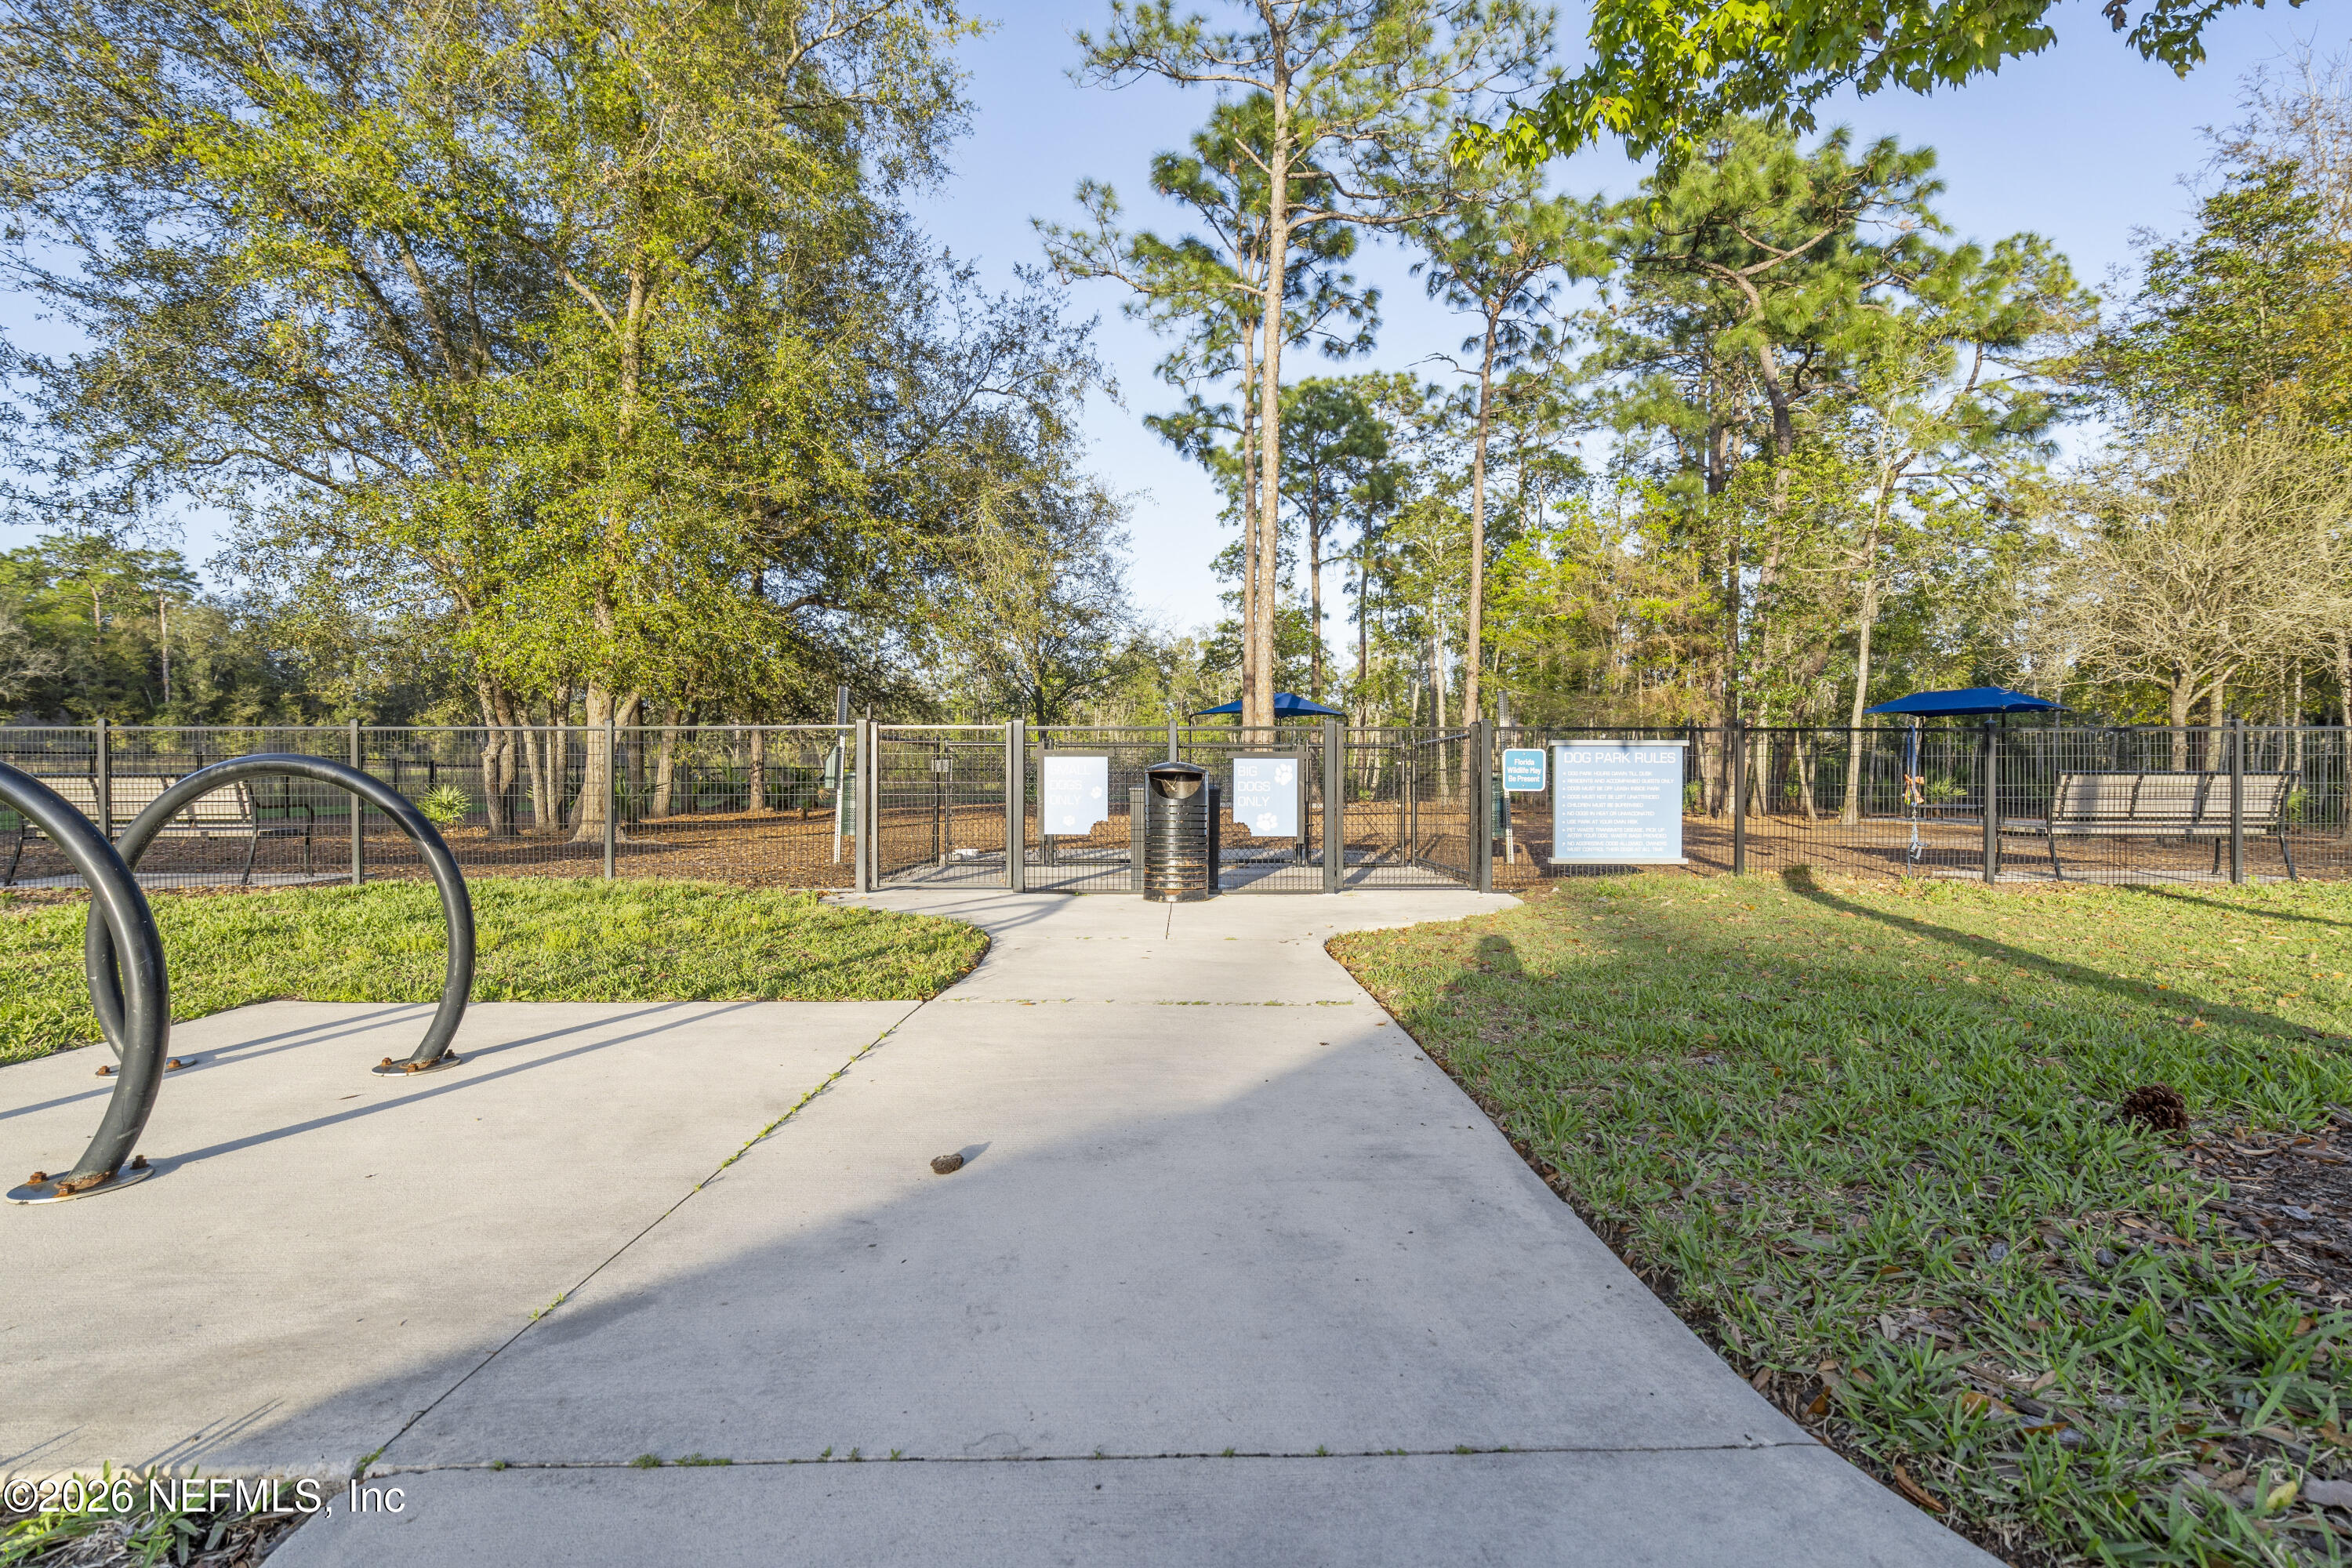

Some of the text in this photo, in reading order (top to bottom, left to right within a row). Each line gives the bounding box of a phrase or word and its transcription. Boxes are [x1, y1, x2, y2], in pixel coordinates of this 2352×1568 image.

[1564, 753, 1675, 763] DOG PARK RULES
[1050, 764, 1091, 775] SMALL
[1238, 765, 1258, 776] BIG
[1530, 767, 1541, 775] May
[1049, 779, 1082, 789] DOGS
[1238, 781, 1271, 791] DOGS
[1049, 796, 1081, 805] ONLY
[1238, 796, 1270, 807] ONLY
